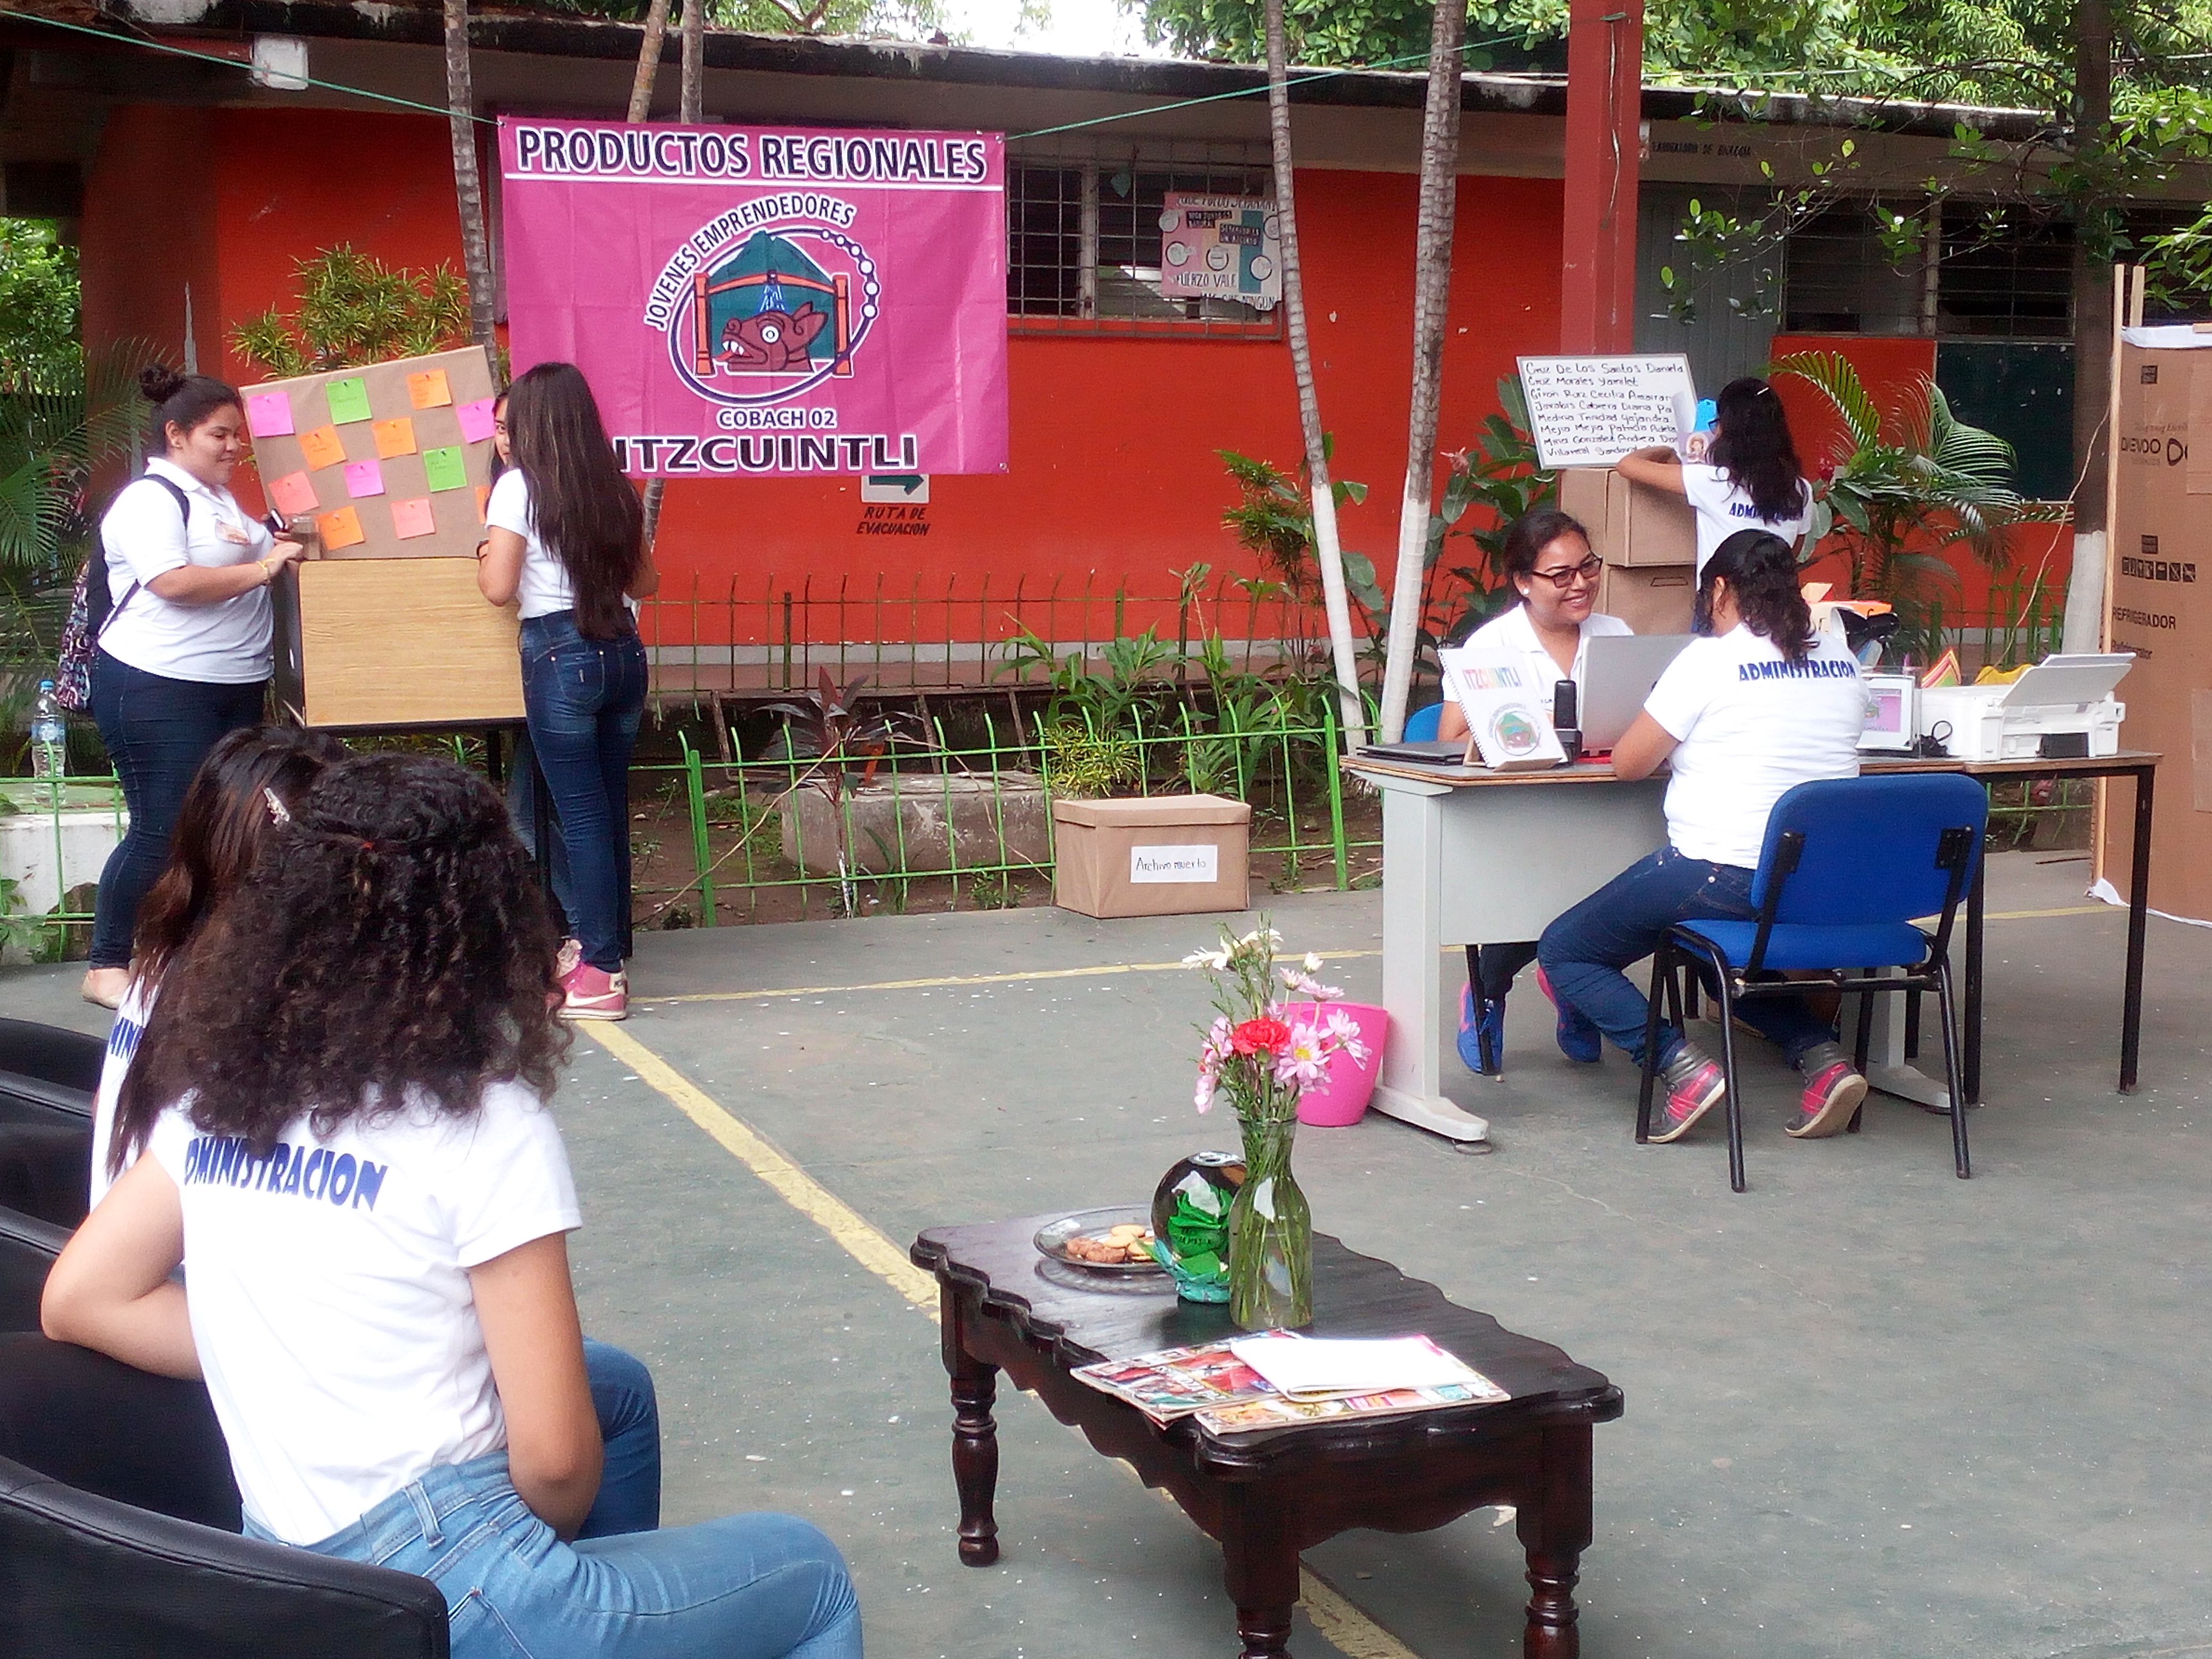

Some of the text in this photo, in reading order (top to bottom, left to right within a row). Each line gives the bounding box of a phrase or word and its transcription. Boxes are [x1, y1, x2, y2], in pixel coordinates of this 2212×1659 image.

[518, 129, 986, 181] PRODUCTOS REGIONALES
[645, 195, 854, 330] JOVENES EMPRENDEDORES
[1213, 274, 1236, 288] VALE
[1556, 364, 1572, 374] De
[1576, 363, 1595, 372] Los
[1556, 377, 1594, 386] Morales
[1657, 405, 1672, 414] Pa
[718, 409, 836, 428] COBACH 02
[613, 437, 916, 470] ITZCUINTLI
[864, 506, 927, 520] RUTA DE
[856, 522, 931, 536] EVACUACION
[2113, 607, 2176, 630] REFRIGERADOR
[184, 1136, 388, 1212] DMINISTRACION
